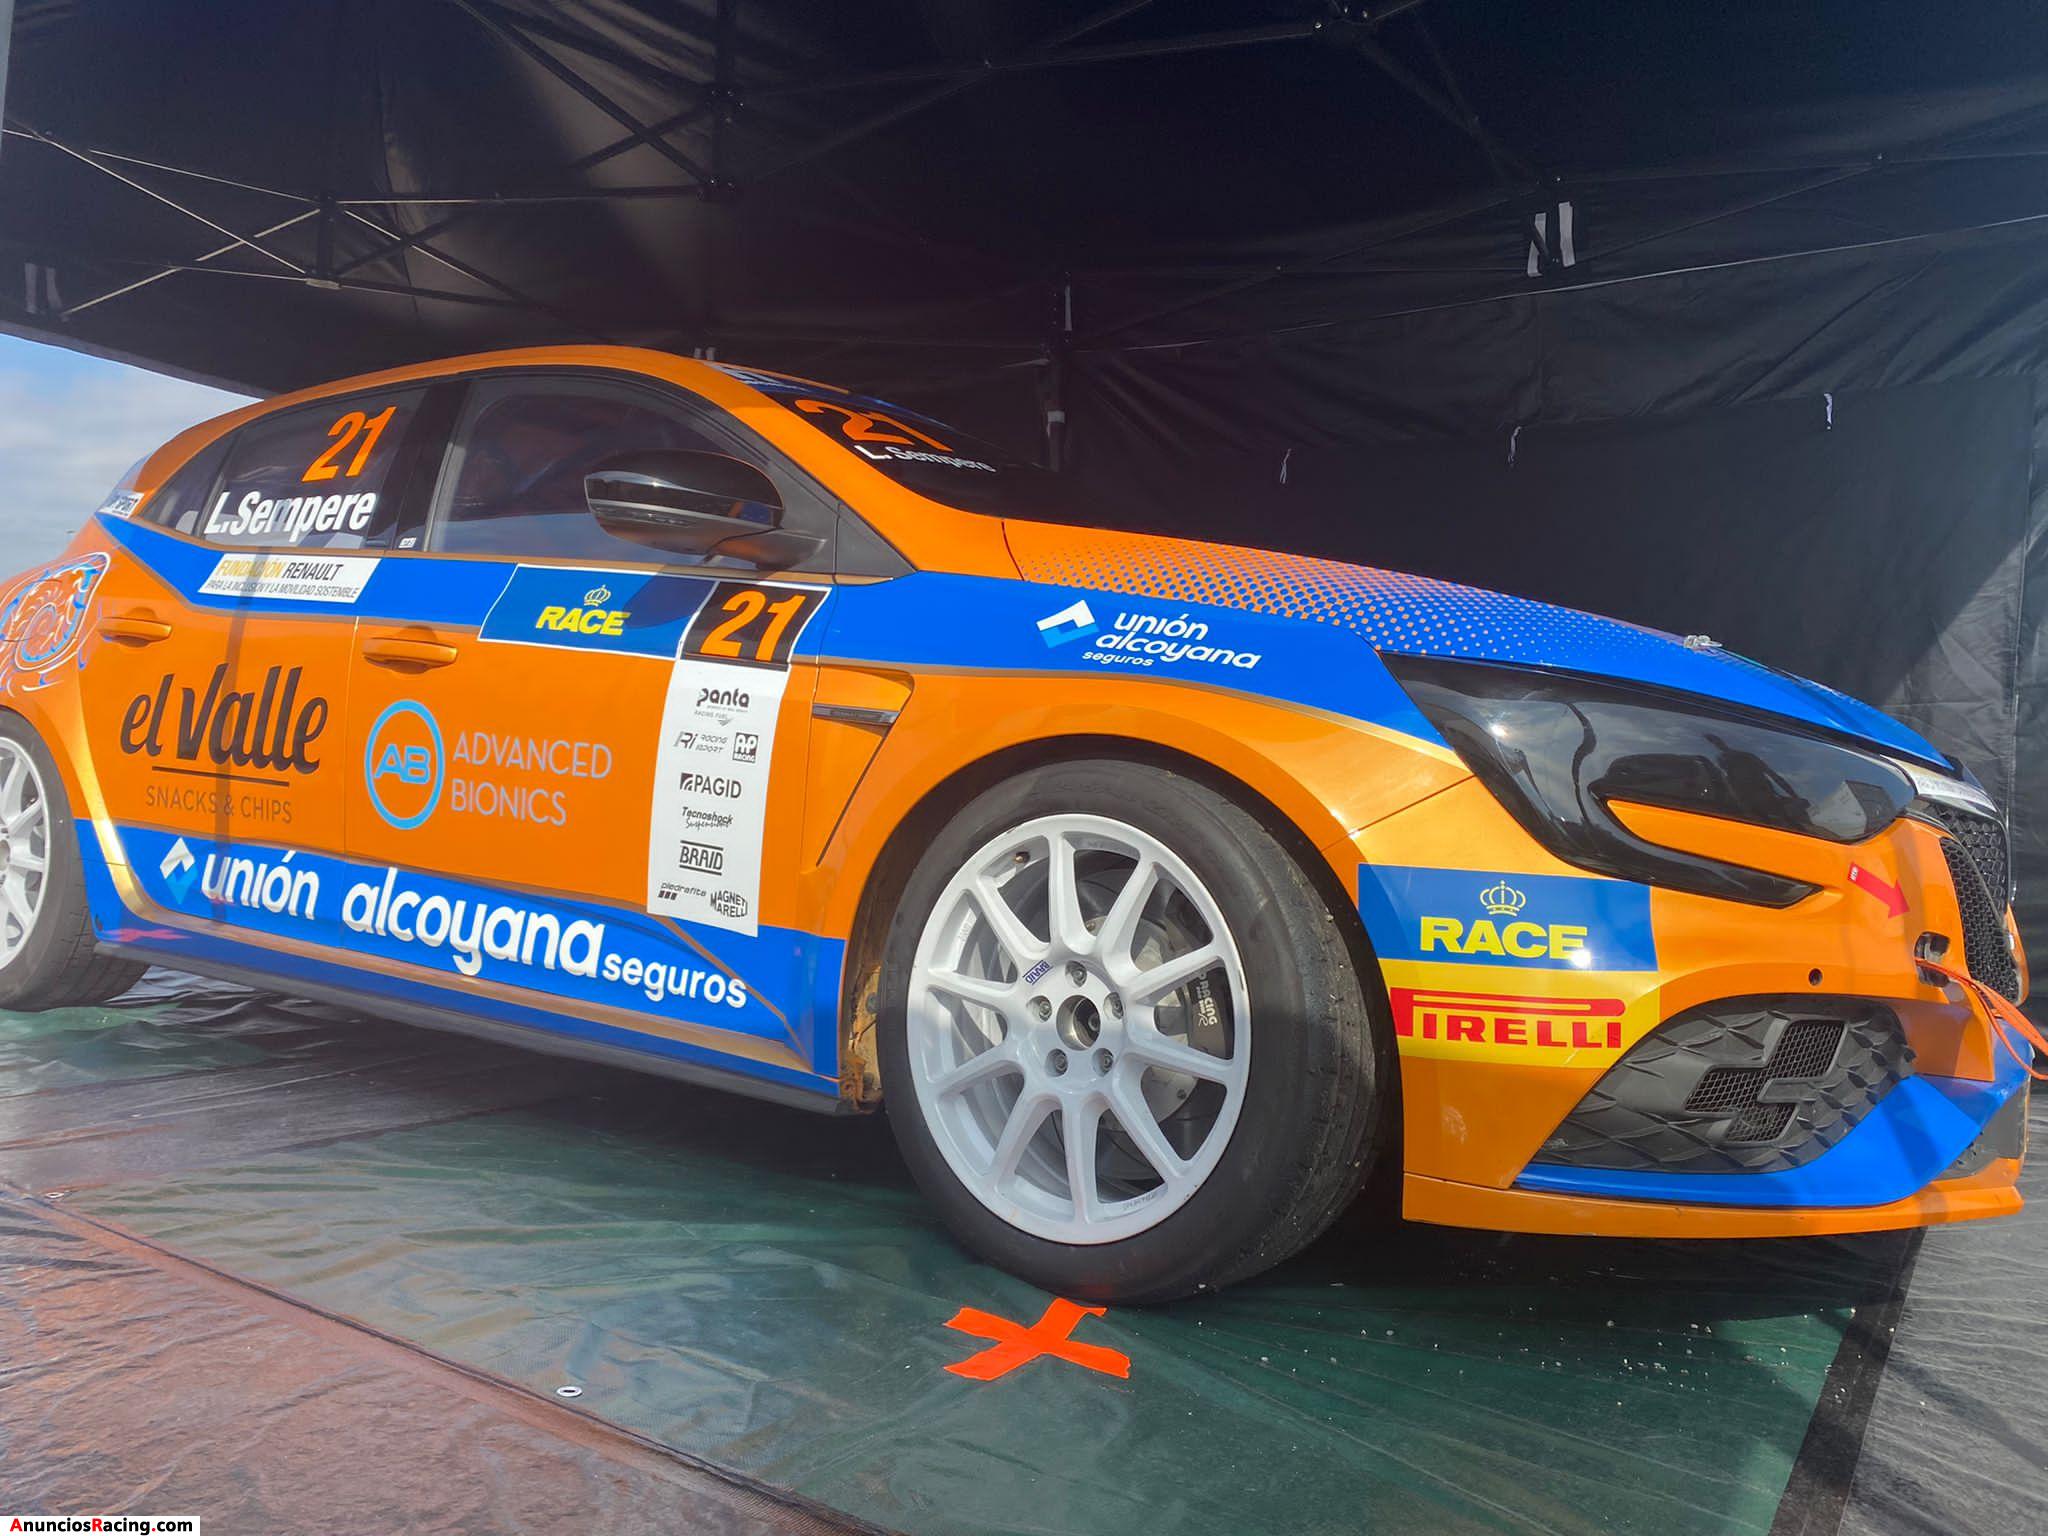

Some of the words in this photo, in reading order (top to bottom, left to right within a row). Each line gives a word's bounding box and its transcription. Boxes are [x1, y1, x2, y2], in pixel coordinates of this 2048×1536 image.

[302, 406, 397, 482] 21
[795, 399, 953, 452] 21
[281, 562, 344, 581] RENAULT
[535, 605, 631, 636] RACE
[700, 590, 806, 662] 21
[1113, 611, 1209, 641] unión
[1081, 650, 1154, 667] seguros
[1095, 632, 1262, 669] alcoyana
[120, 673, 175, 757] el
[176, 662, 328, 774] Valle
[374, 743, 431, 785] AB
[452, 731, 612, 779] ADVANCED
[145, 785, 218, 814] SNACKS
[223, 794, 235, 816] &
[240, 796, 293, 824] CHIPS
[450, 777, 567, 826] BIONICS
[694, 774, 742, 799] PAGID
[679, 846, 723, 871] BRAID
[200, 848, 321, 920] unión
[341, 867, 606, 976] alcoyana
[1420, 916, 1588, 960] RACE
[601, 950, 748, 1008] seguros
[1390, 987, 1626, 1049] PIRELLI
